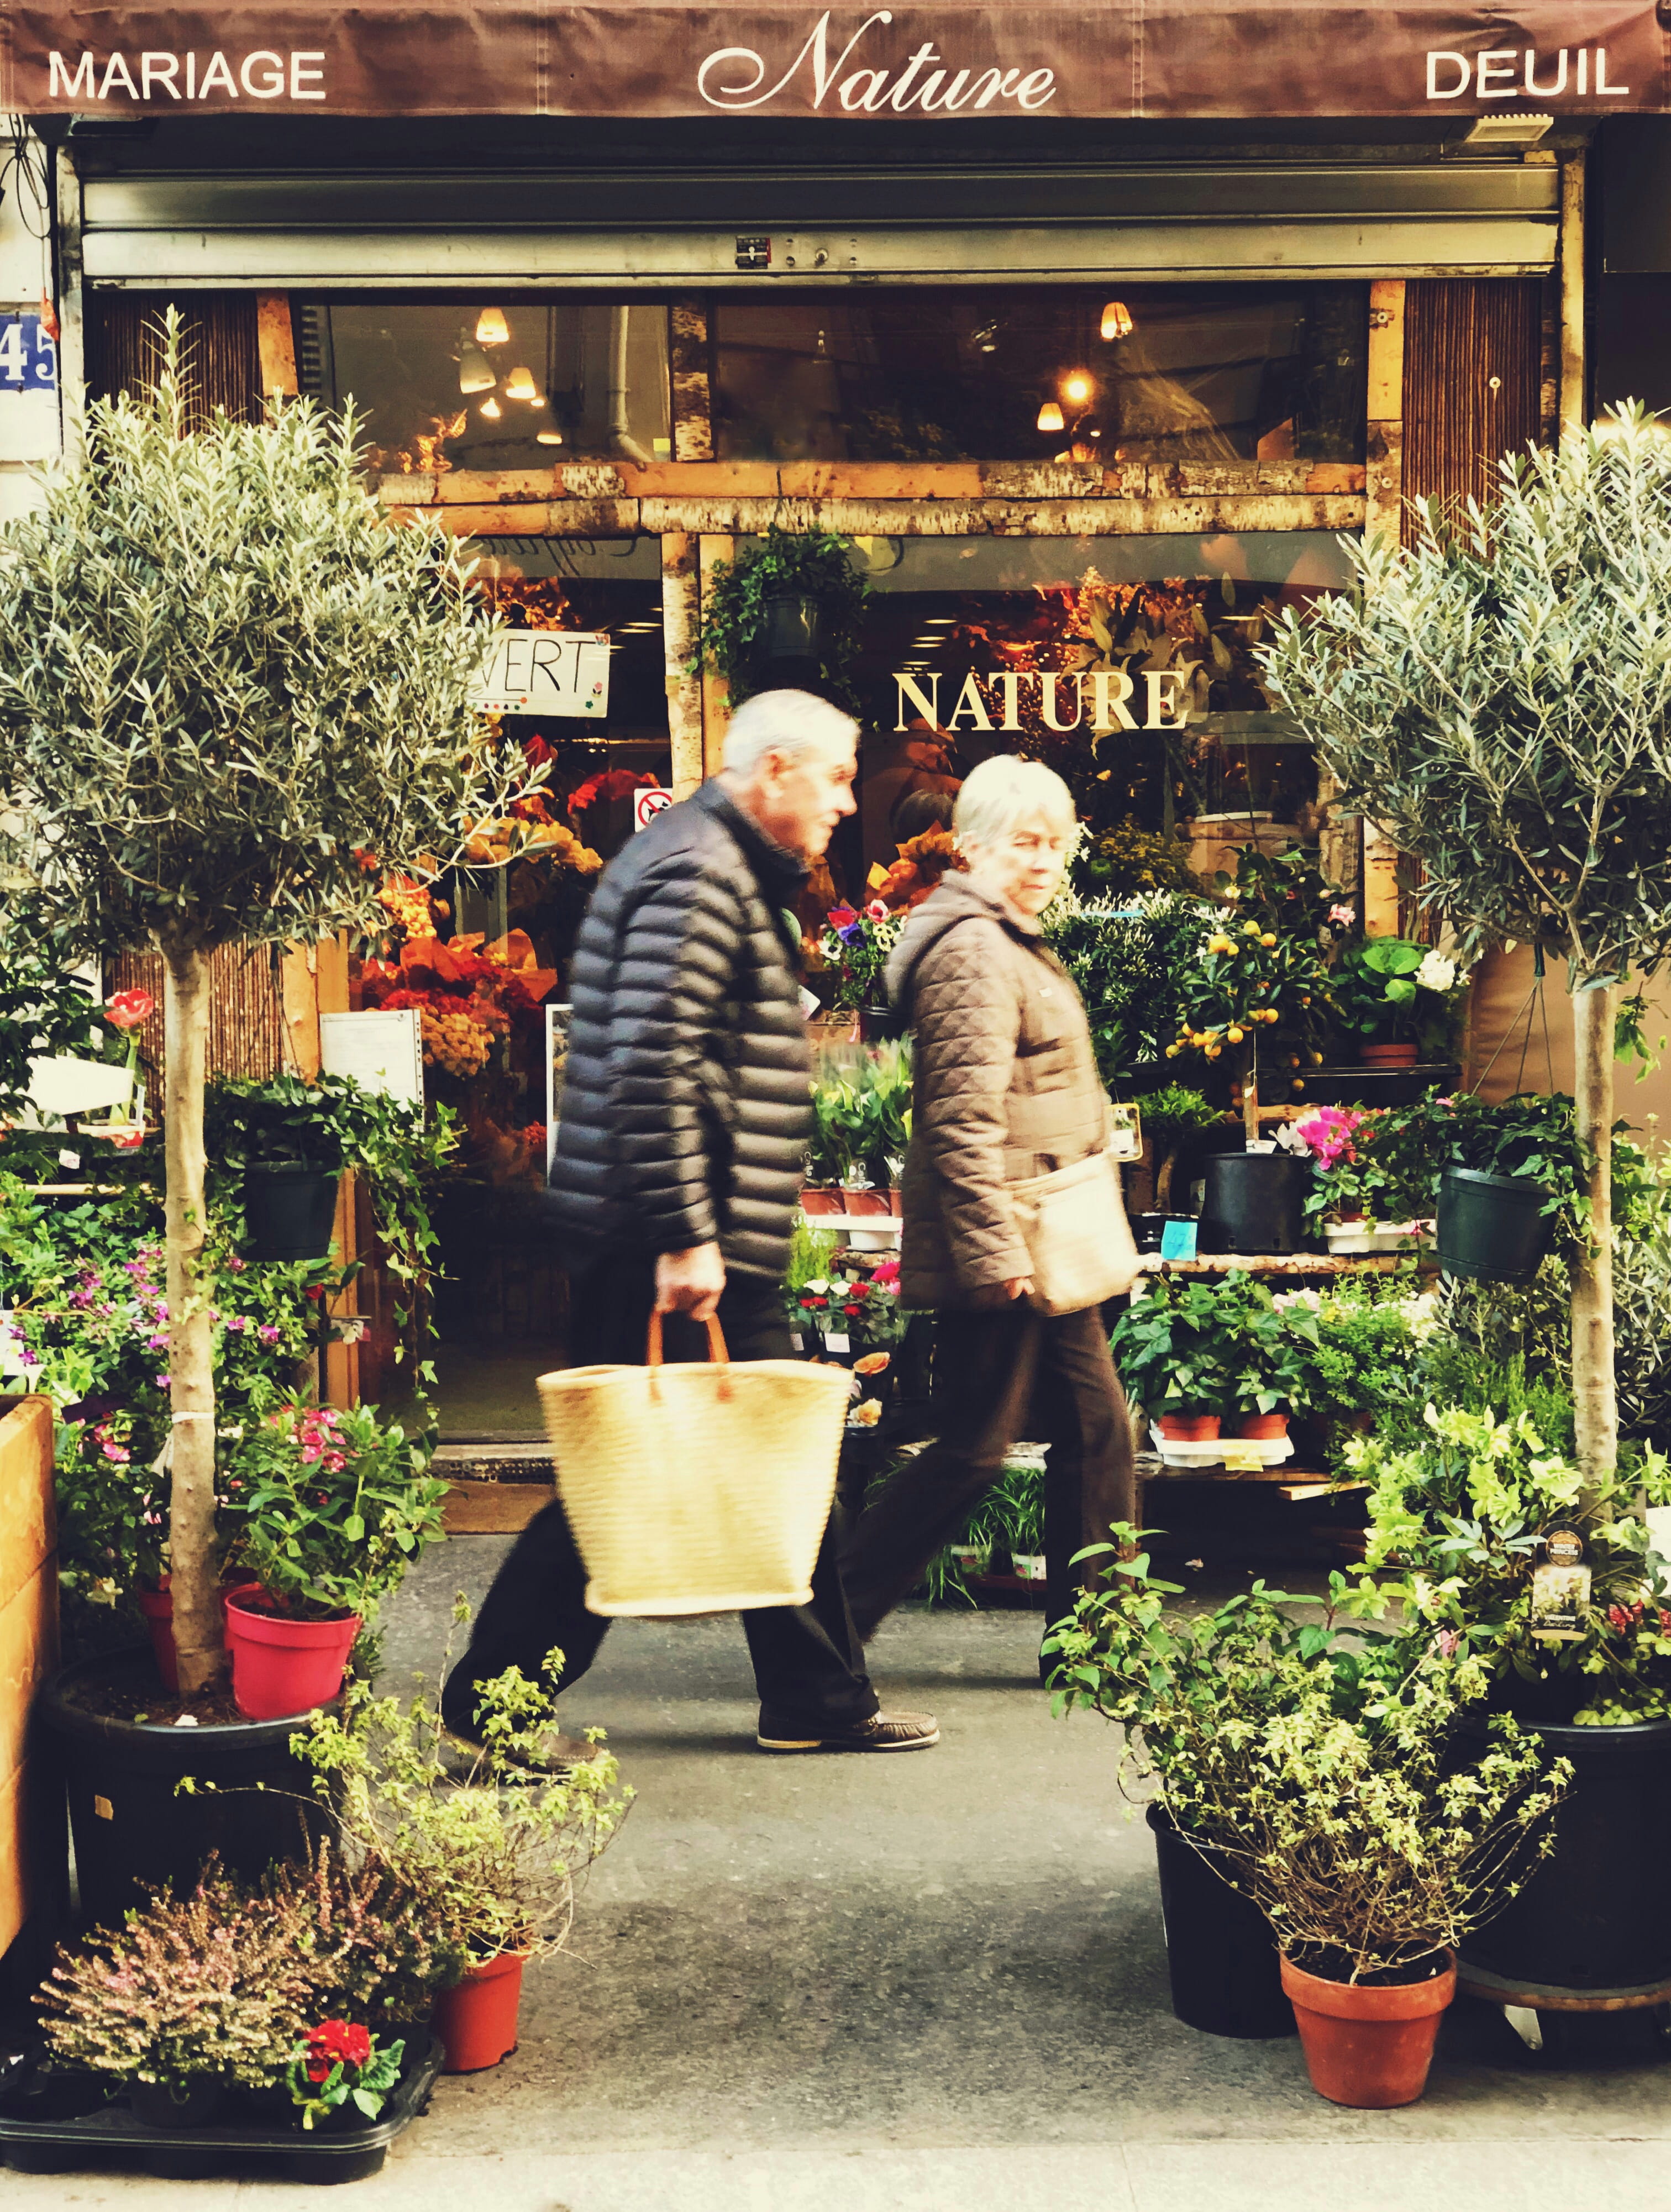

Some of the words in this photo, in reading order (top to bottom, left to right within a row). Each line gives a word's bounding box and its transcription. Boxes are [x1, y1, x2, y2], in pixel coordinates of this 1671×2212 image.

[49, 51, 327, 100] MARIAGE
[697, 10, 1057, 112] Nature
[1426, 48, 1630, 99] DEUIL
[0, 323, 56, 381] 45
[892, 669, 1189, 732] NATURE
[804, 1151, 814, 1176] Calla
[858, 1162, 866, 1183] Call
